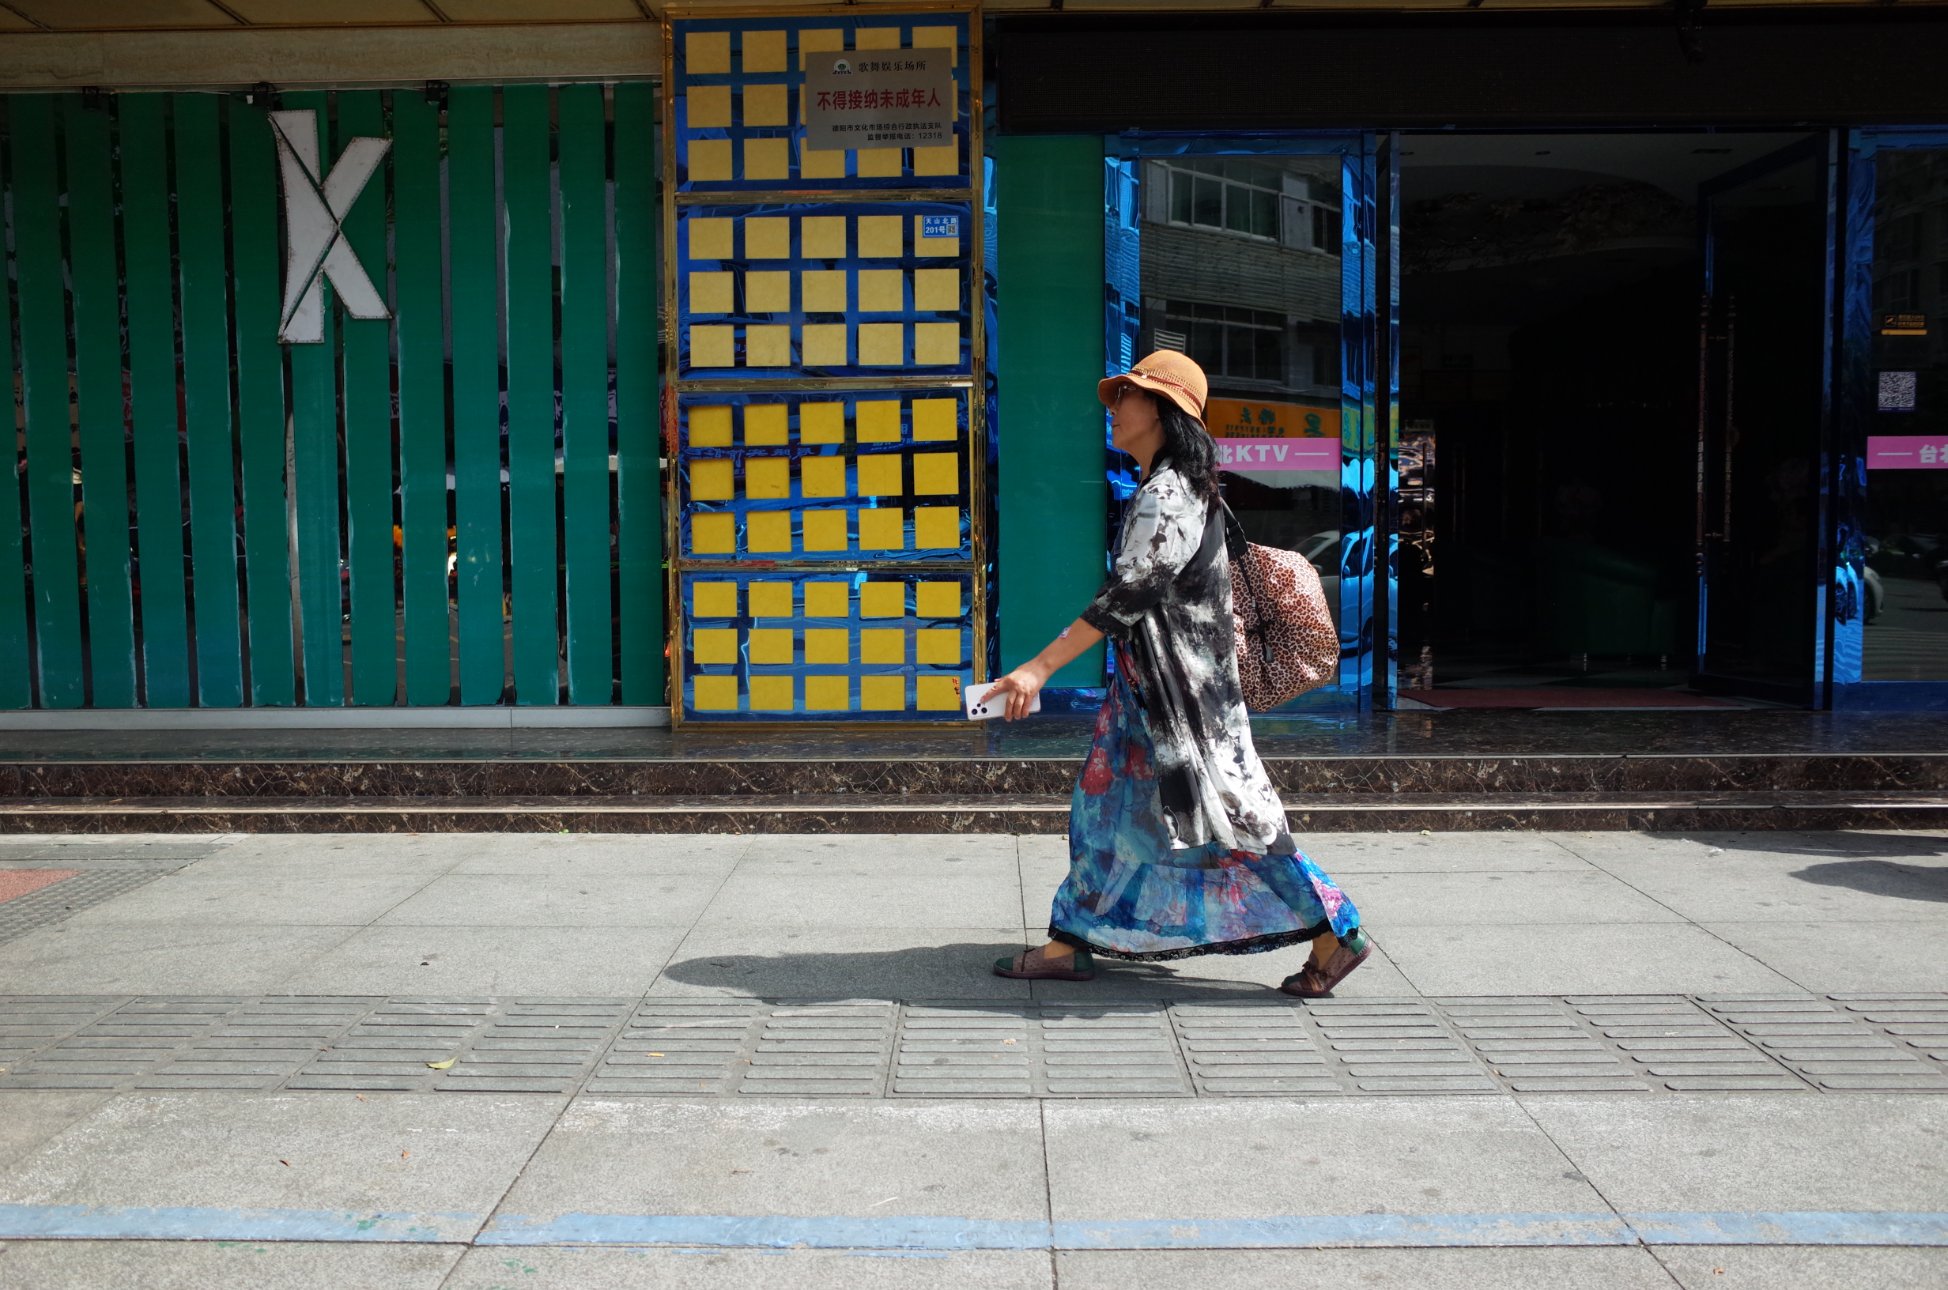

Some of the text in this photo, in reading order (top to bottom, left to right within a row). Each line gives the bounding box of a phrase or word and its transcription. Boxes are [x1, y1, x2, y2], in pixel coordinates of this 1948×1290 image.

[858, 60, 926, 73] 歌舞娱乐场所
[817, 88, 941, 111] 不得接纳未成年人
[925, 225, 946, 234] 201号
